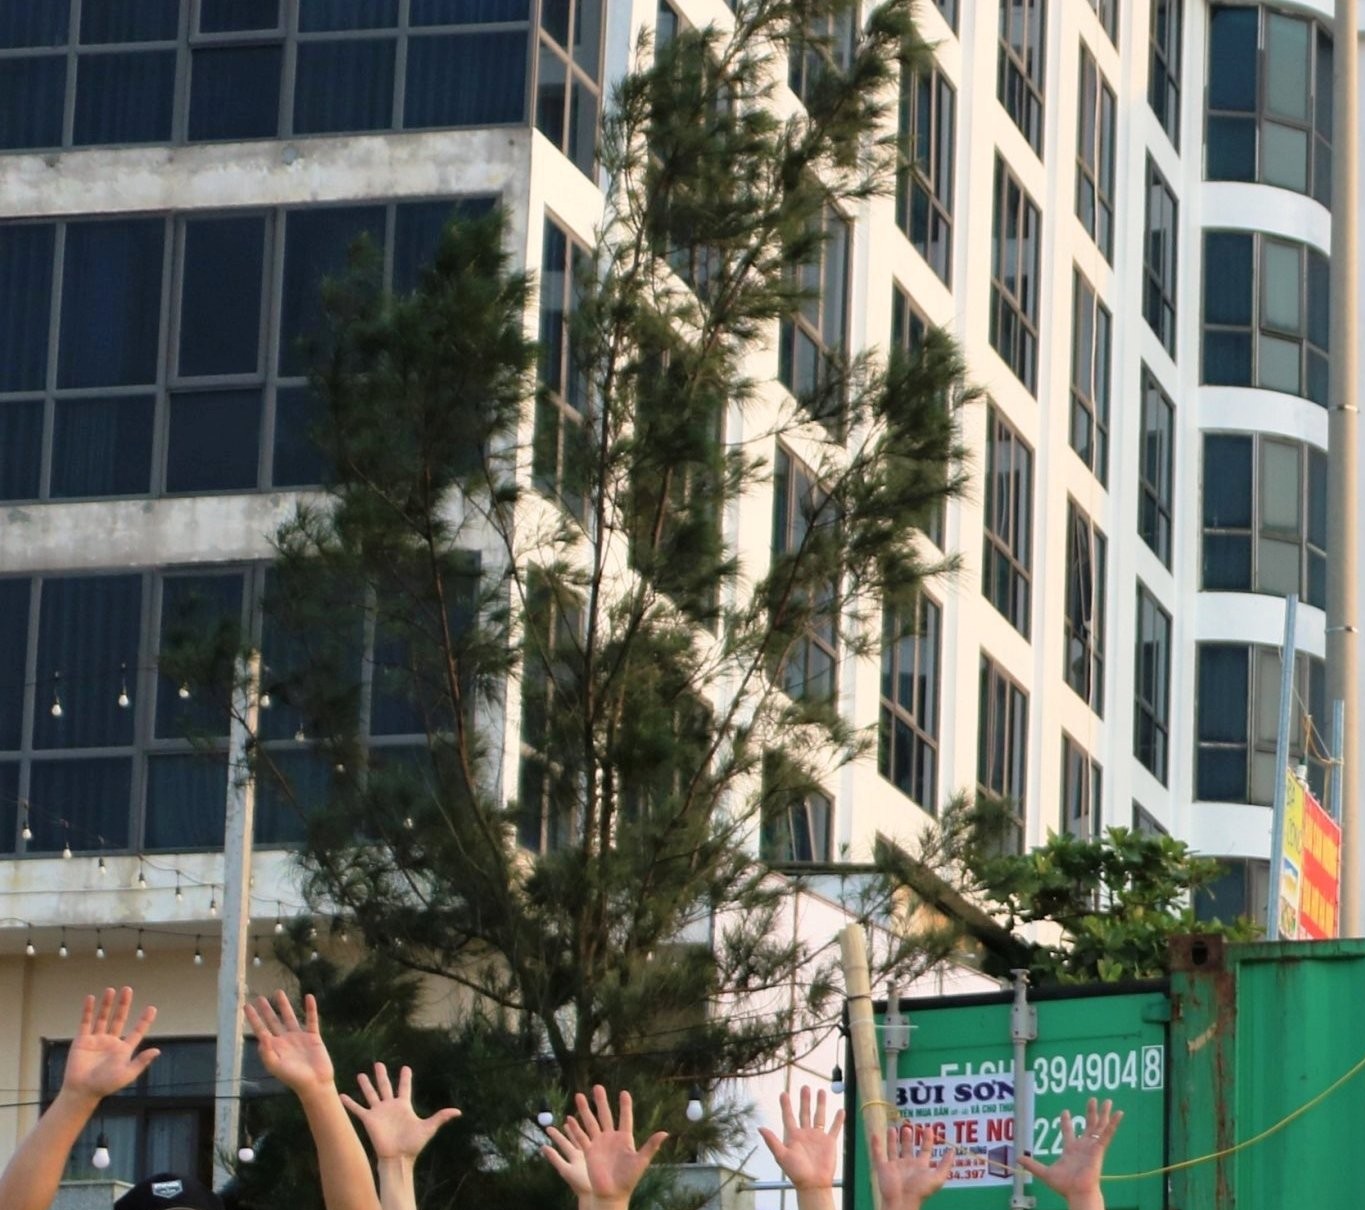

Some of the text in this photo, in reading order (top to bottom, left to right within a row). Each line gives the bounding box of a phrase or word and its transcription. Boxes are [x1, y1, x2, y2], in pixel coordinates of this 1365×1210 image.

[1034, 1051, 1138, 1095] 394904
[1144, 1049, 1160, 1087] 8
[953, 1119, 979, 1144] TE
